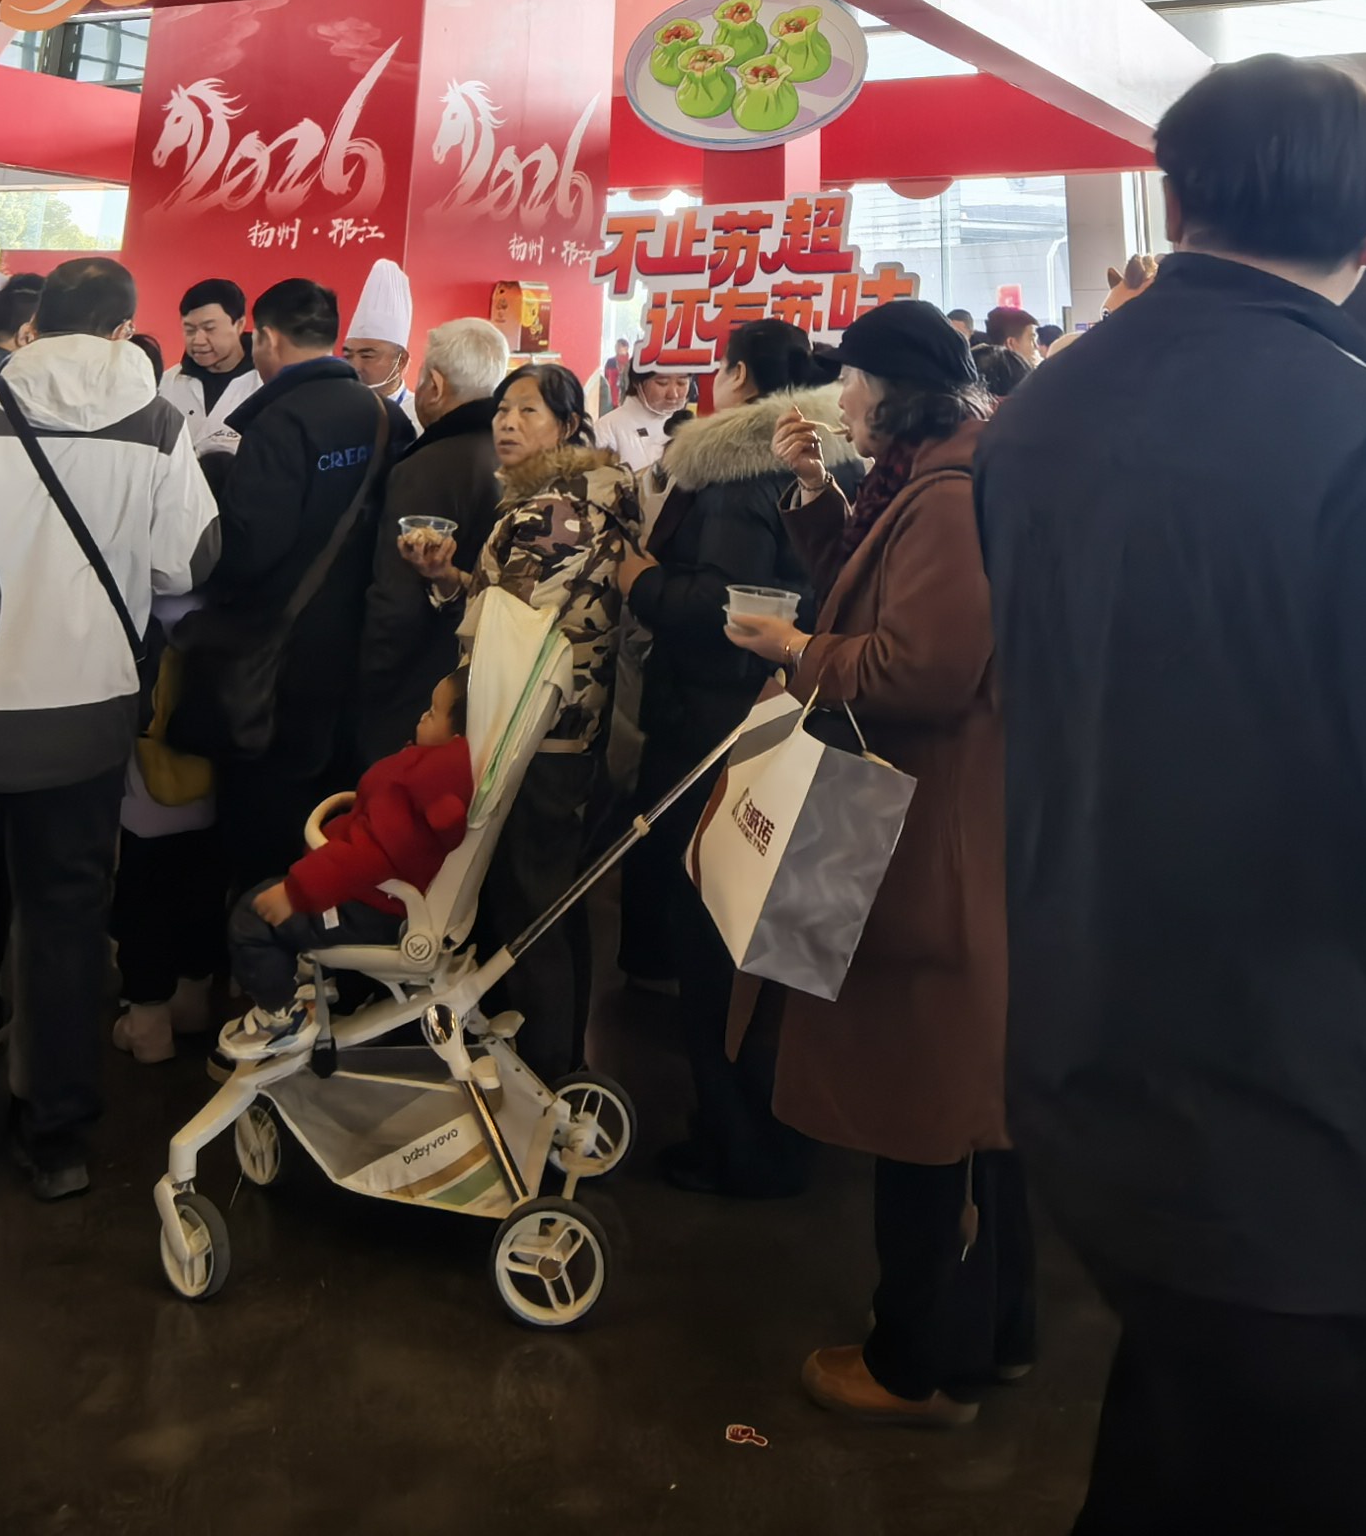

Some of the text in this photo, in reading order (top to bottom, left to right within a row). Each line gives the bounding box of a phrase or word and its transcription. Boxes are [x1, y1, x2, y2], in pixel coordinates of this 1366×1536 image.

[150, 37, 402, 214] 2026
[430, 78, 601, 226] 2026
[594, 197, 854, 295] 不止苏超
[402, 1128, 459, 1165] babyvovo
